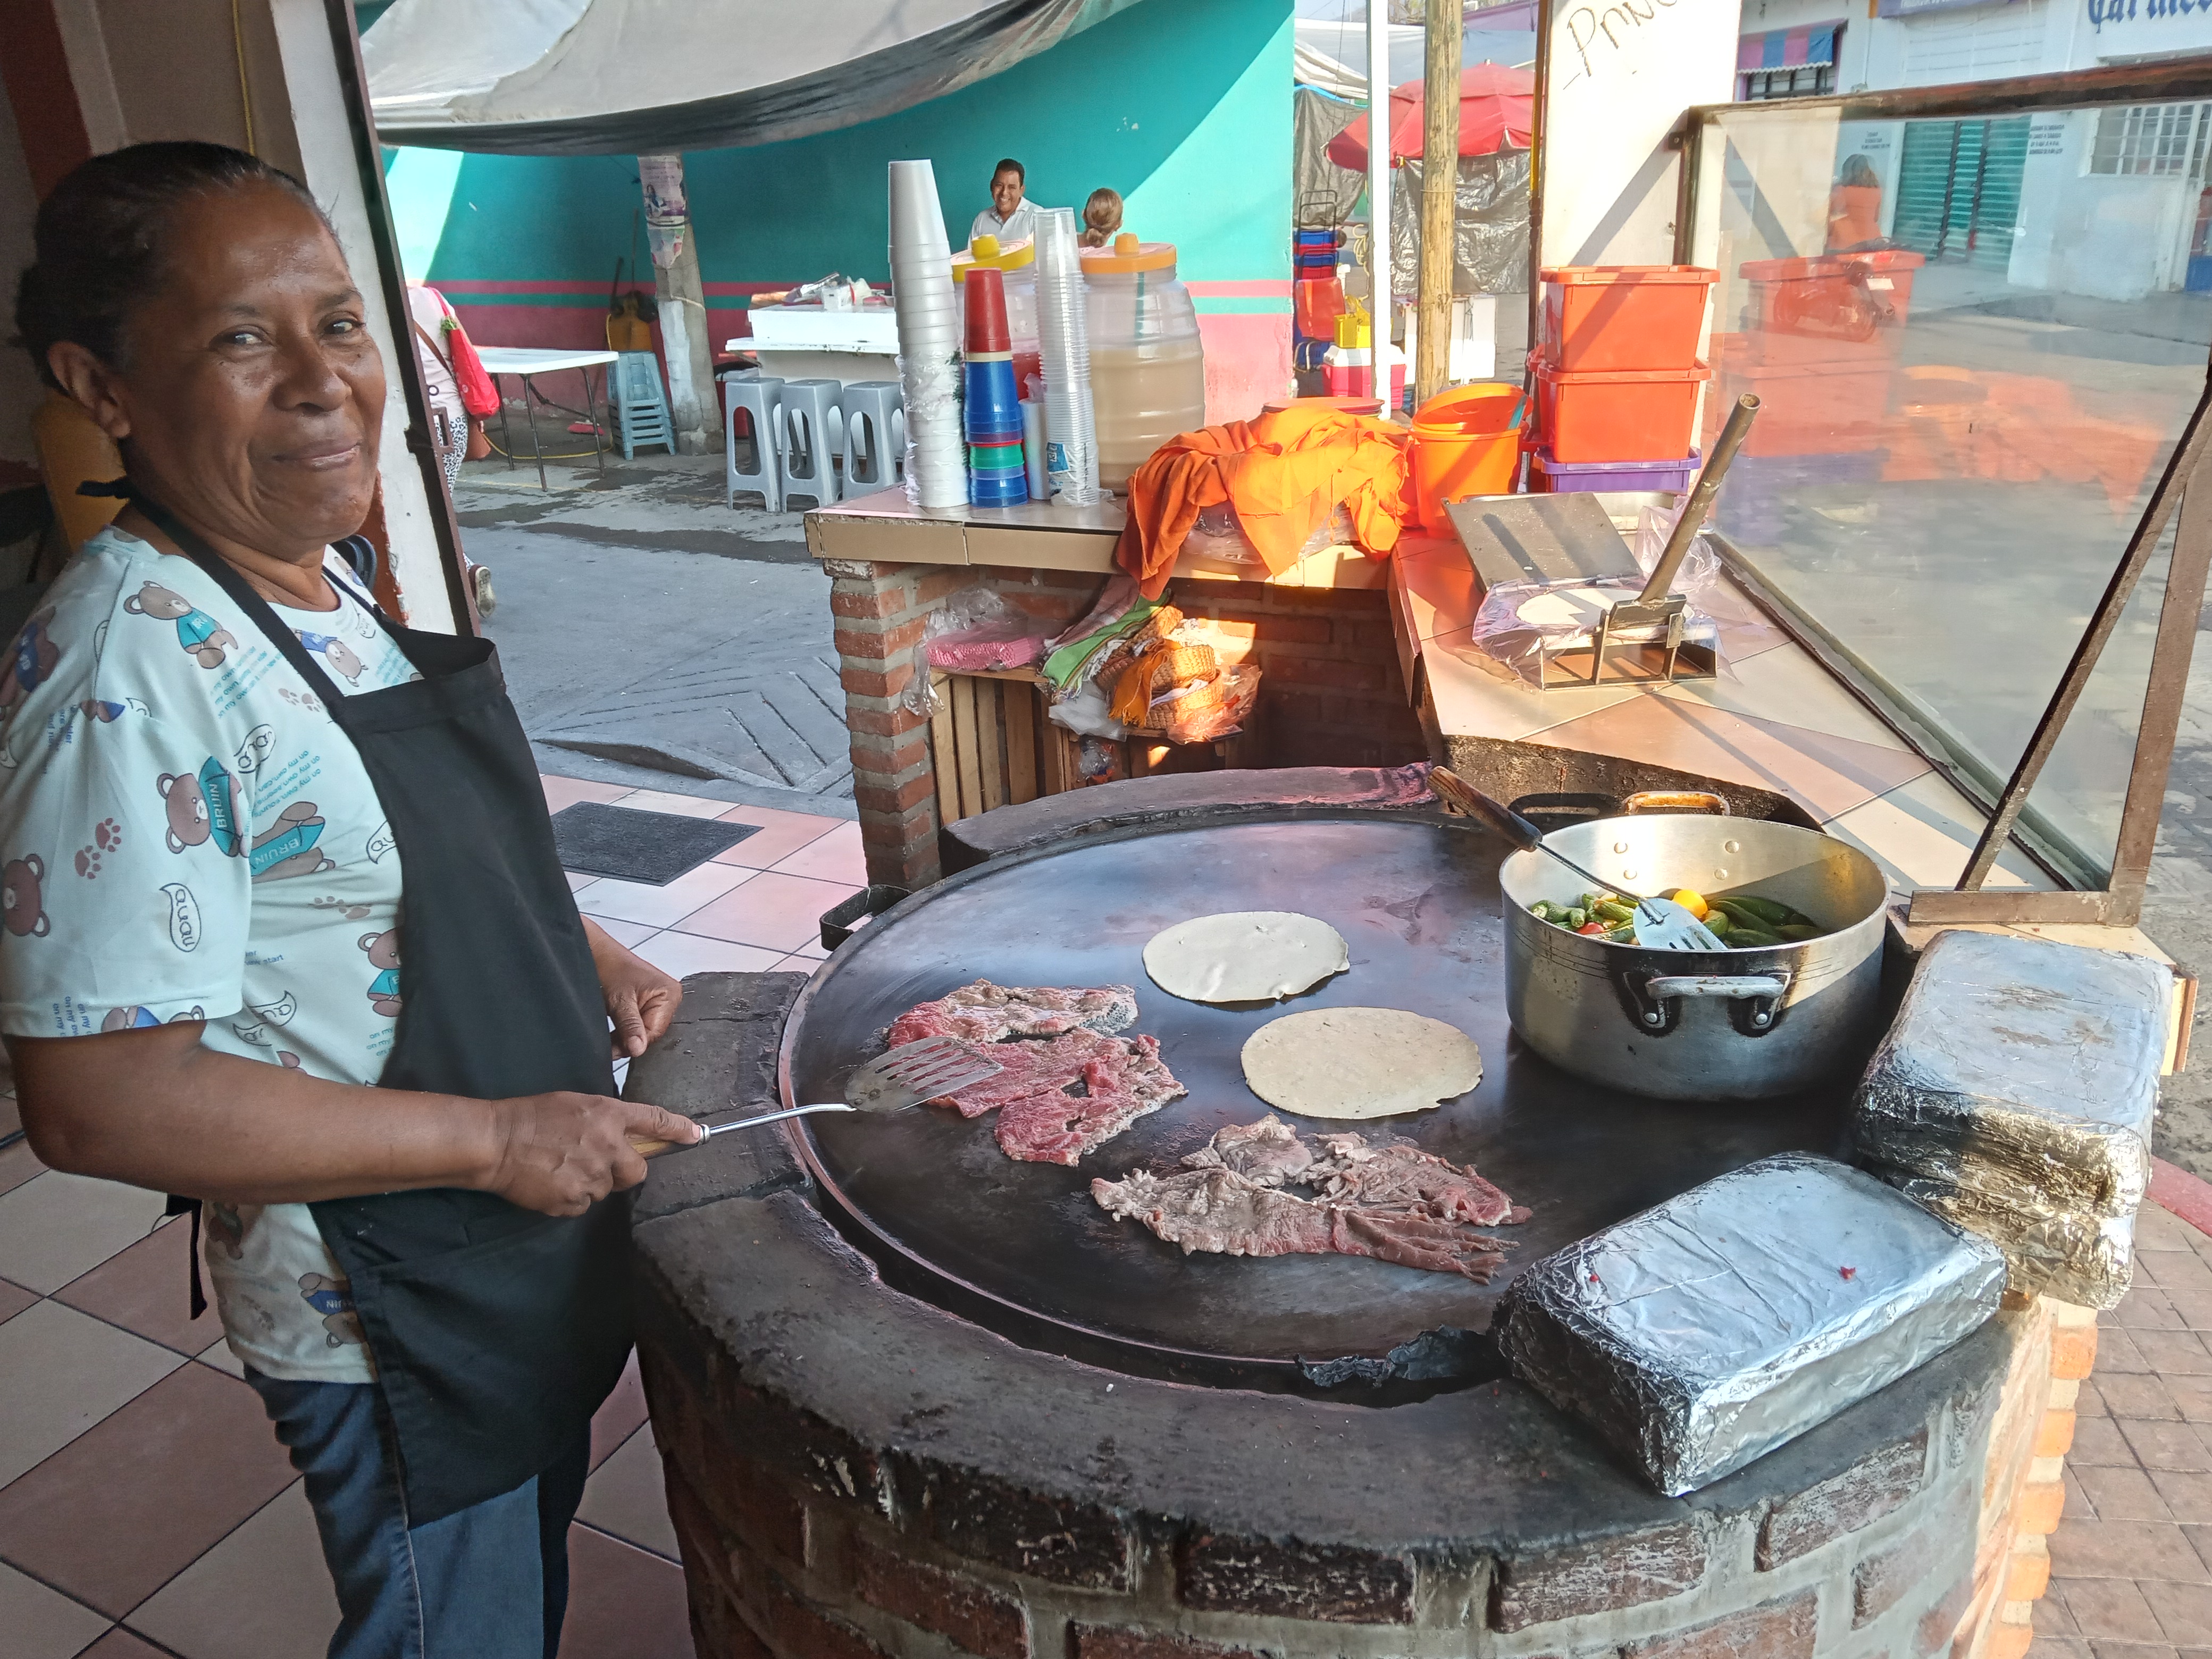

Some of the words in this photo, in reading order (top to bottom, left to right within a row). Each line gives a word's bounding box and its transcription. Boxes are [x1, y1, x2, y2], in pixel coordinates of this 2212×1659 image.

[298, 750, 308, 759] on
[288, 759, 298, 768] my
[299, 763, 311, 773] my
[312, 768, 321, 777] on
[299, 776, 311, 787] my
[208, 783, 228, 828] BRUIN
[255, 838, 299, 865] BRUIN
[65, 996, 71, 1007] on
[77, 1003, 86, 1013] on
[66, 1010, 76, 1022] my
[81, 1016, 91, 1028] my
